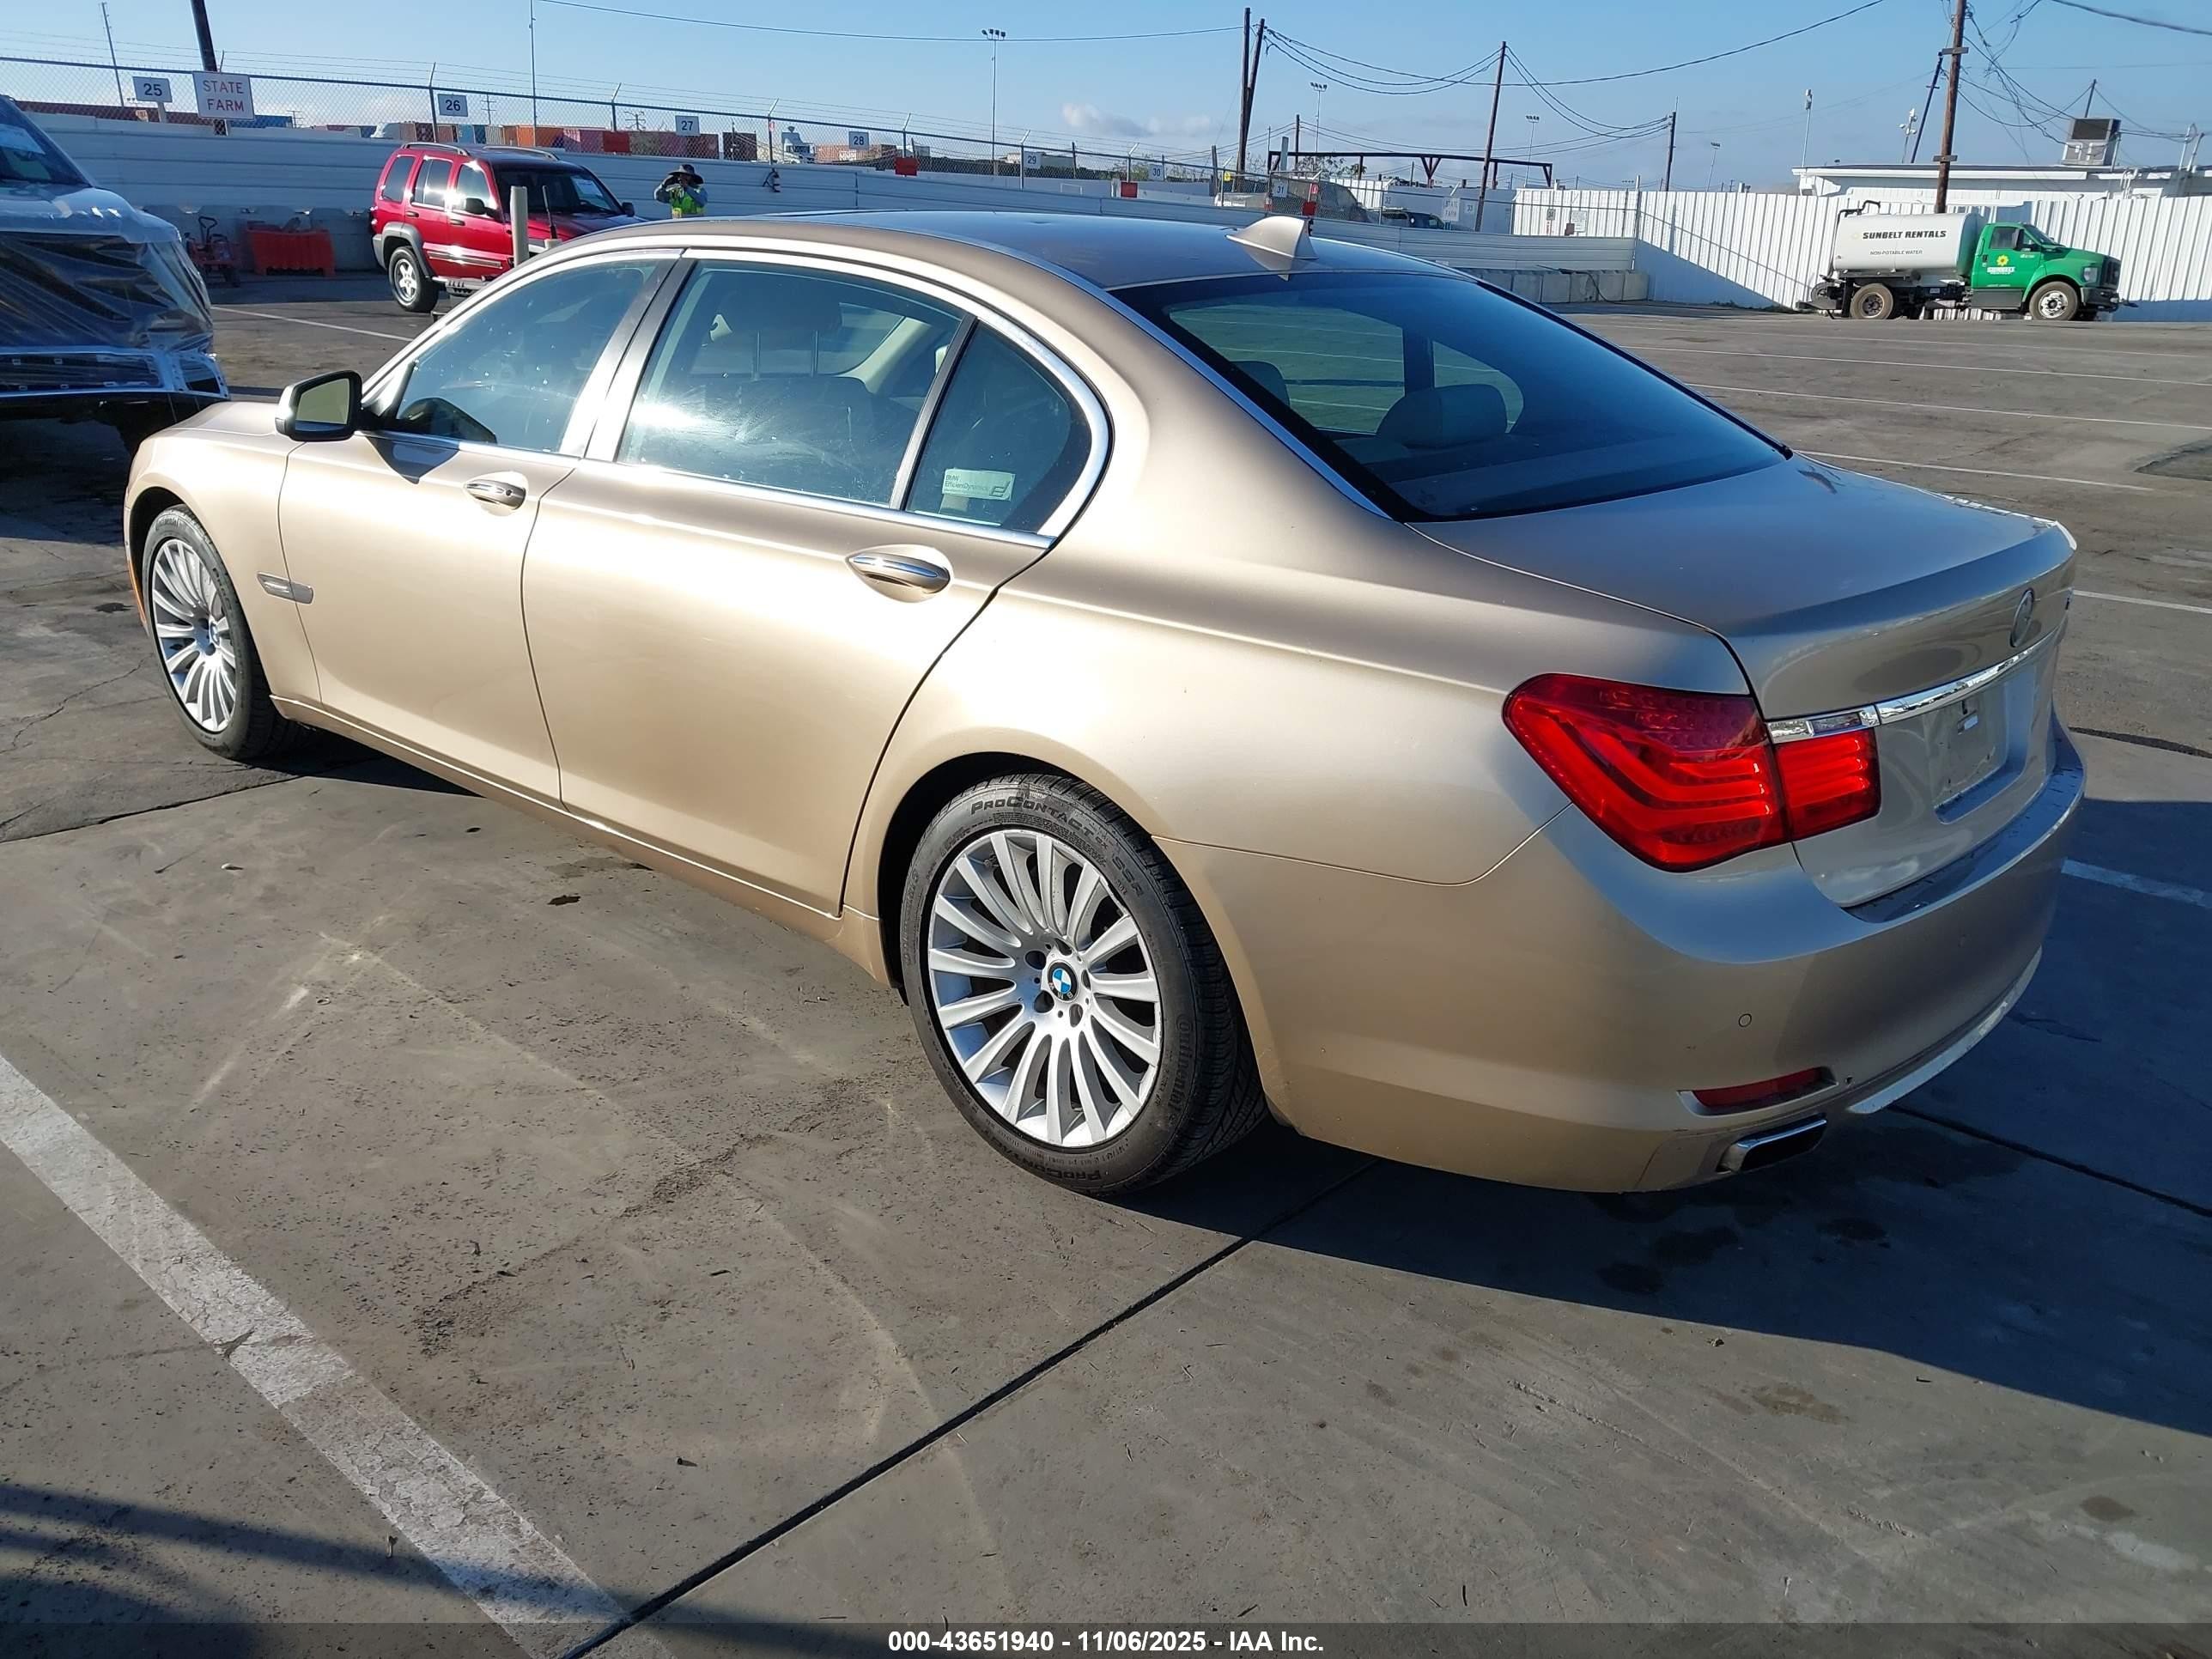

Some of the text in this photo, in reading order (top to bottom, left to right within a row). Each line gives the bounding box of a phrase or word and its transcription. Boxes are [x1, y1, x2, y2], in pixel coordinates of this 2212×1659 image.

[143, 83, 162, 96] 25
[203, 80, 244, 94] STATE
[207, 99, 244, 112] FARM
[445, 99, 461, 112] 26
[681, 120, 693, 131] 27
[853, 136, 865, 146] 28
[1027, 155, 1037, 165] 29
[1152, 167, 1161, 177] 30
[1277, 185, 1285, 194] 31
[1863, 230, 1947, 240] SUNBELT RENTALS
